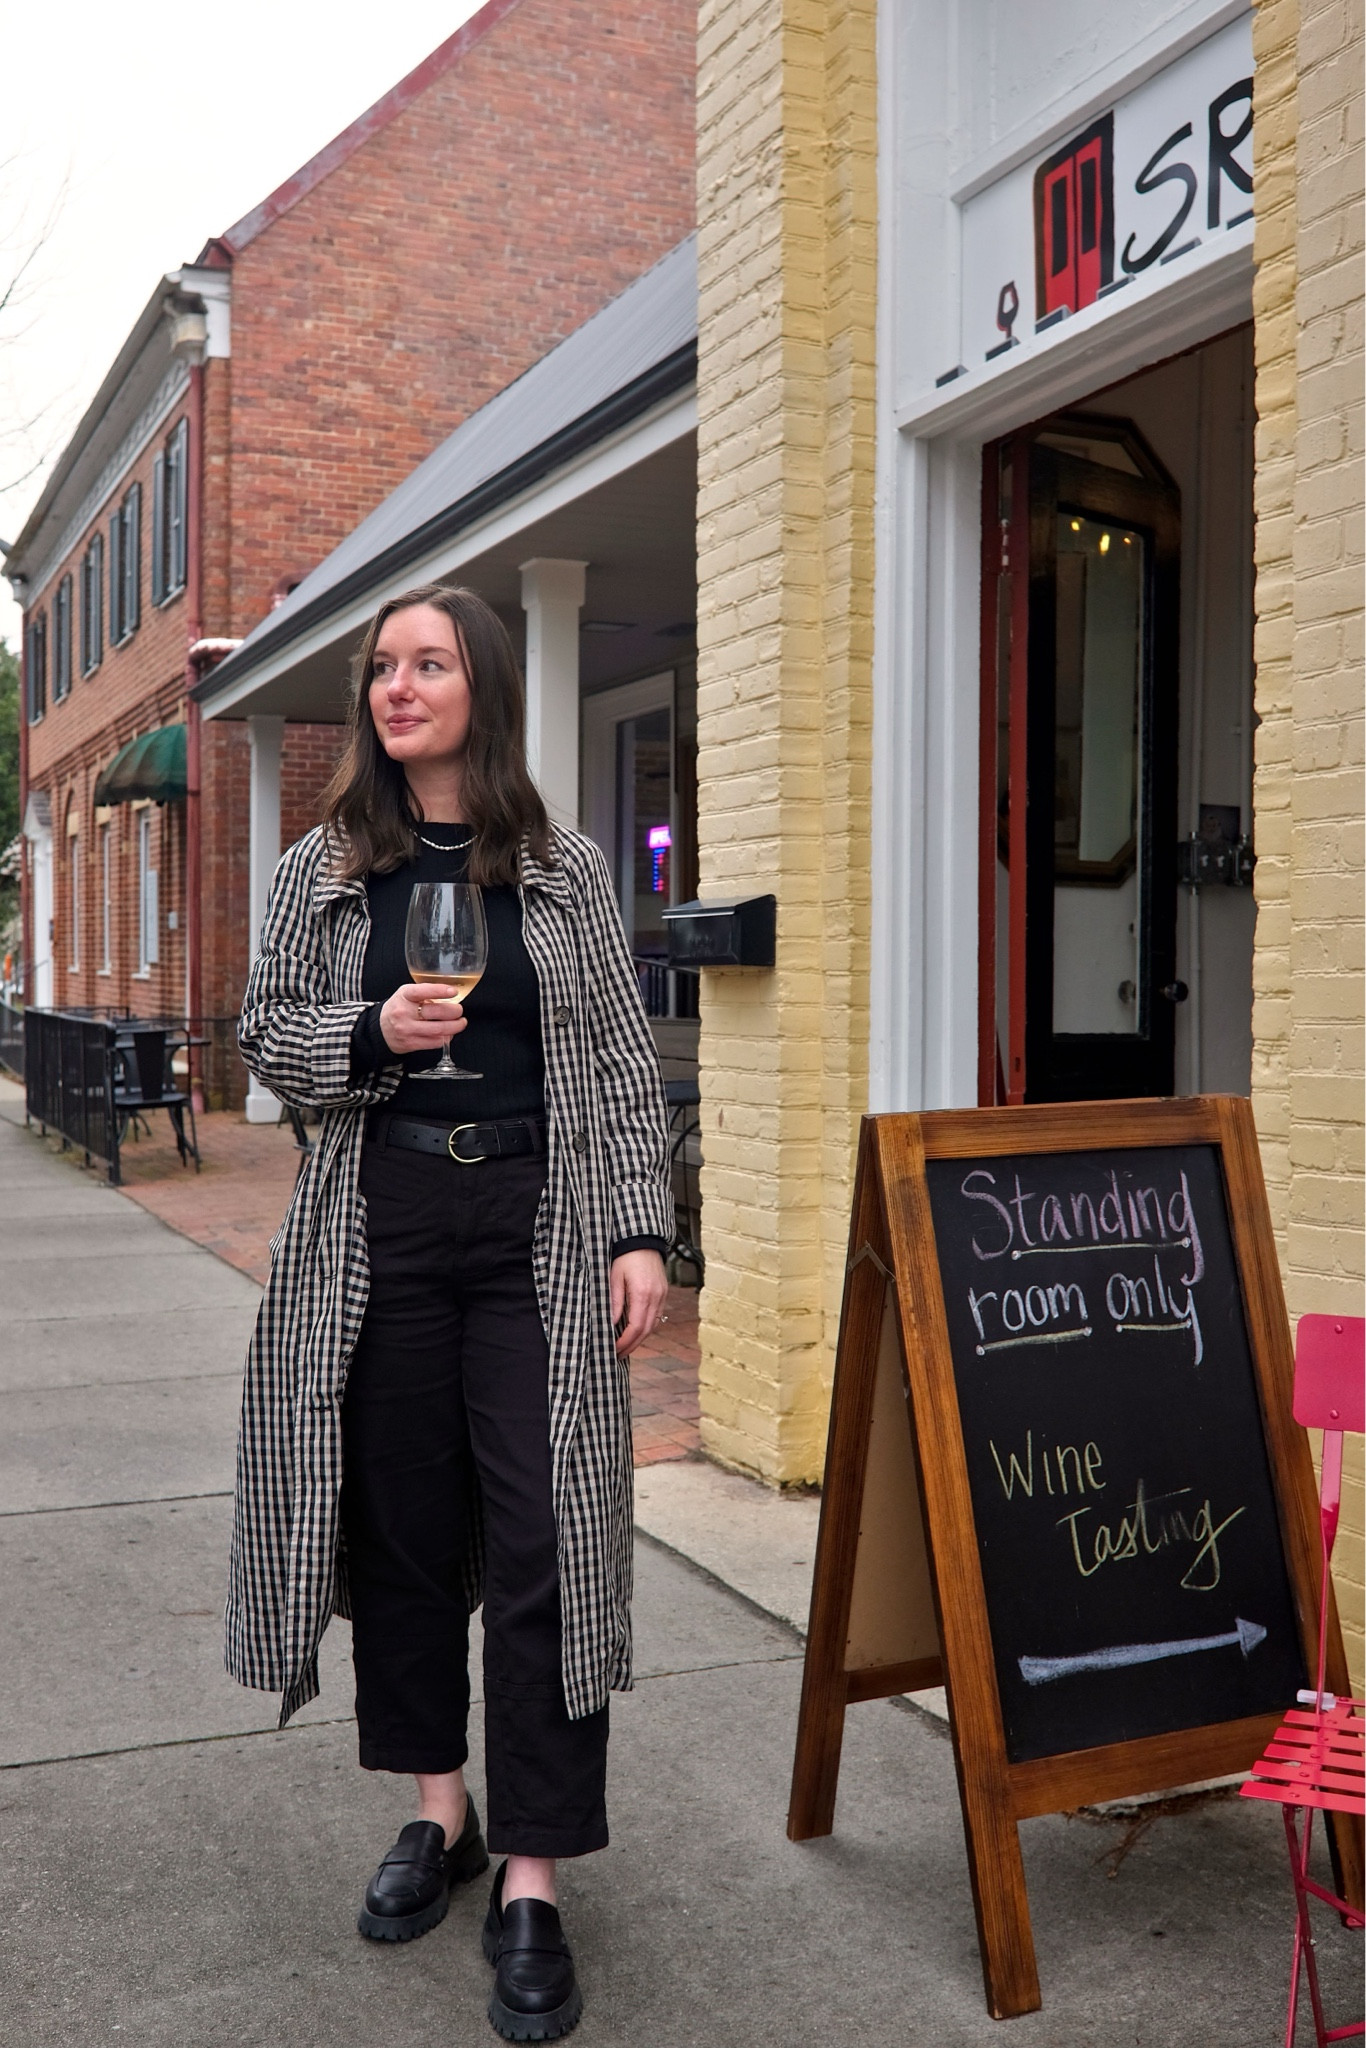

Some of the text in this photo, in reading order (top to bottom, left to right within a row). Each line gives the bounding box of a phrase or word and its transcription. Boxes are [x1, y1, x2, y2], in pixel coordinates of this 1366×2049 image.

[961, 1169, 1203, 1286] Standing
[967, 1253, 1202, 1365] room only
[990, 1429, 1107, 1501] Wine
[1056, 1478, 1246, 1590] Tasting
